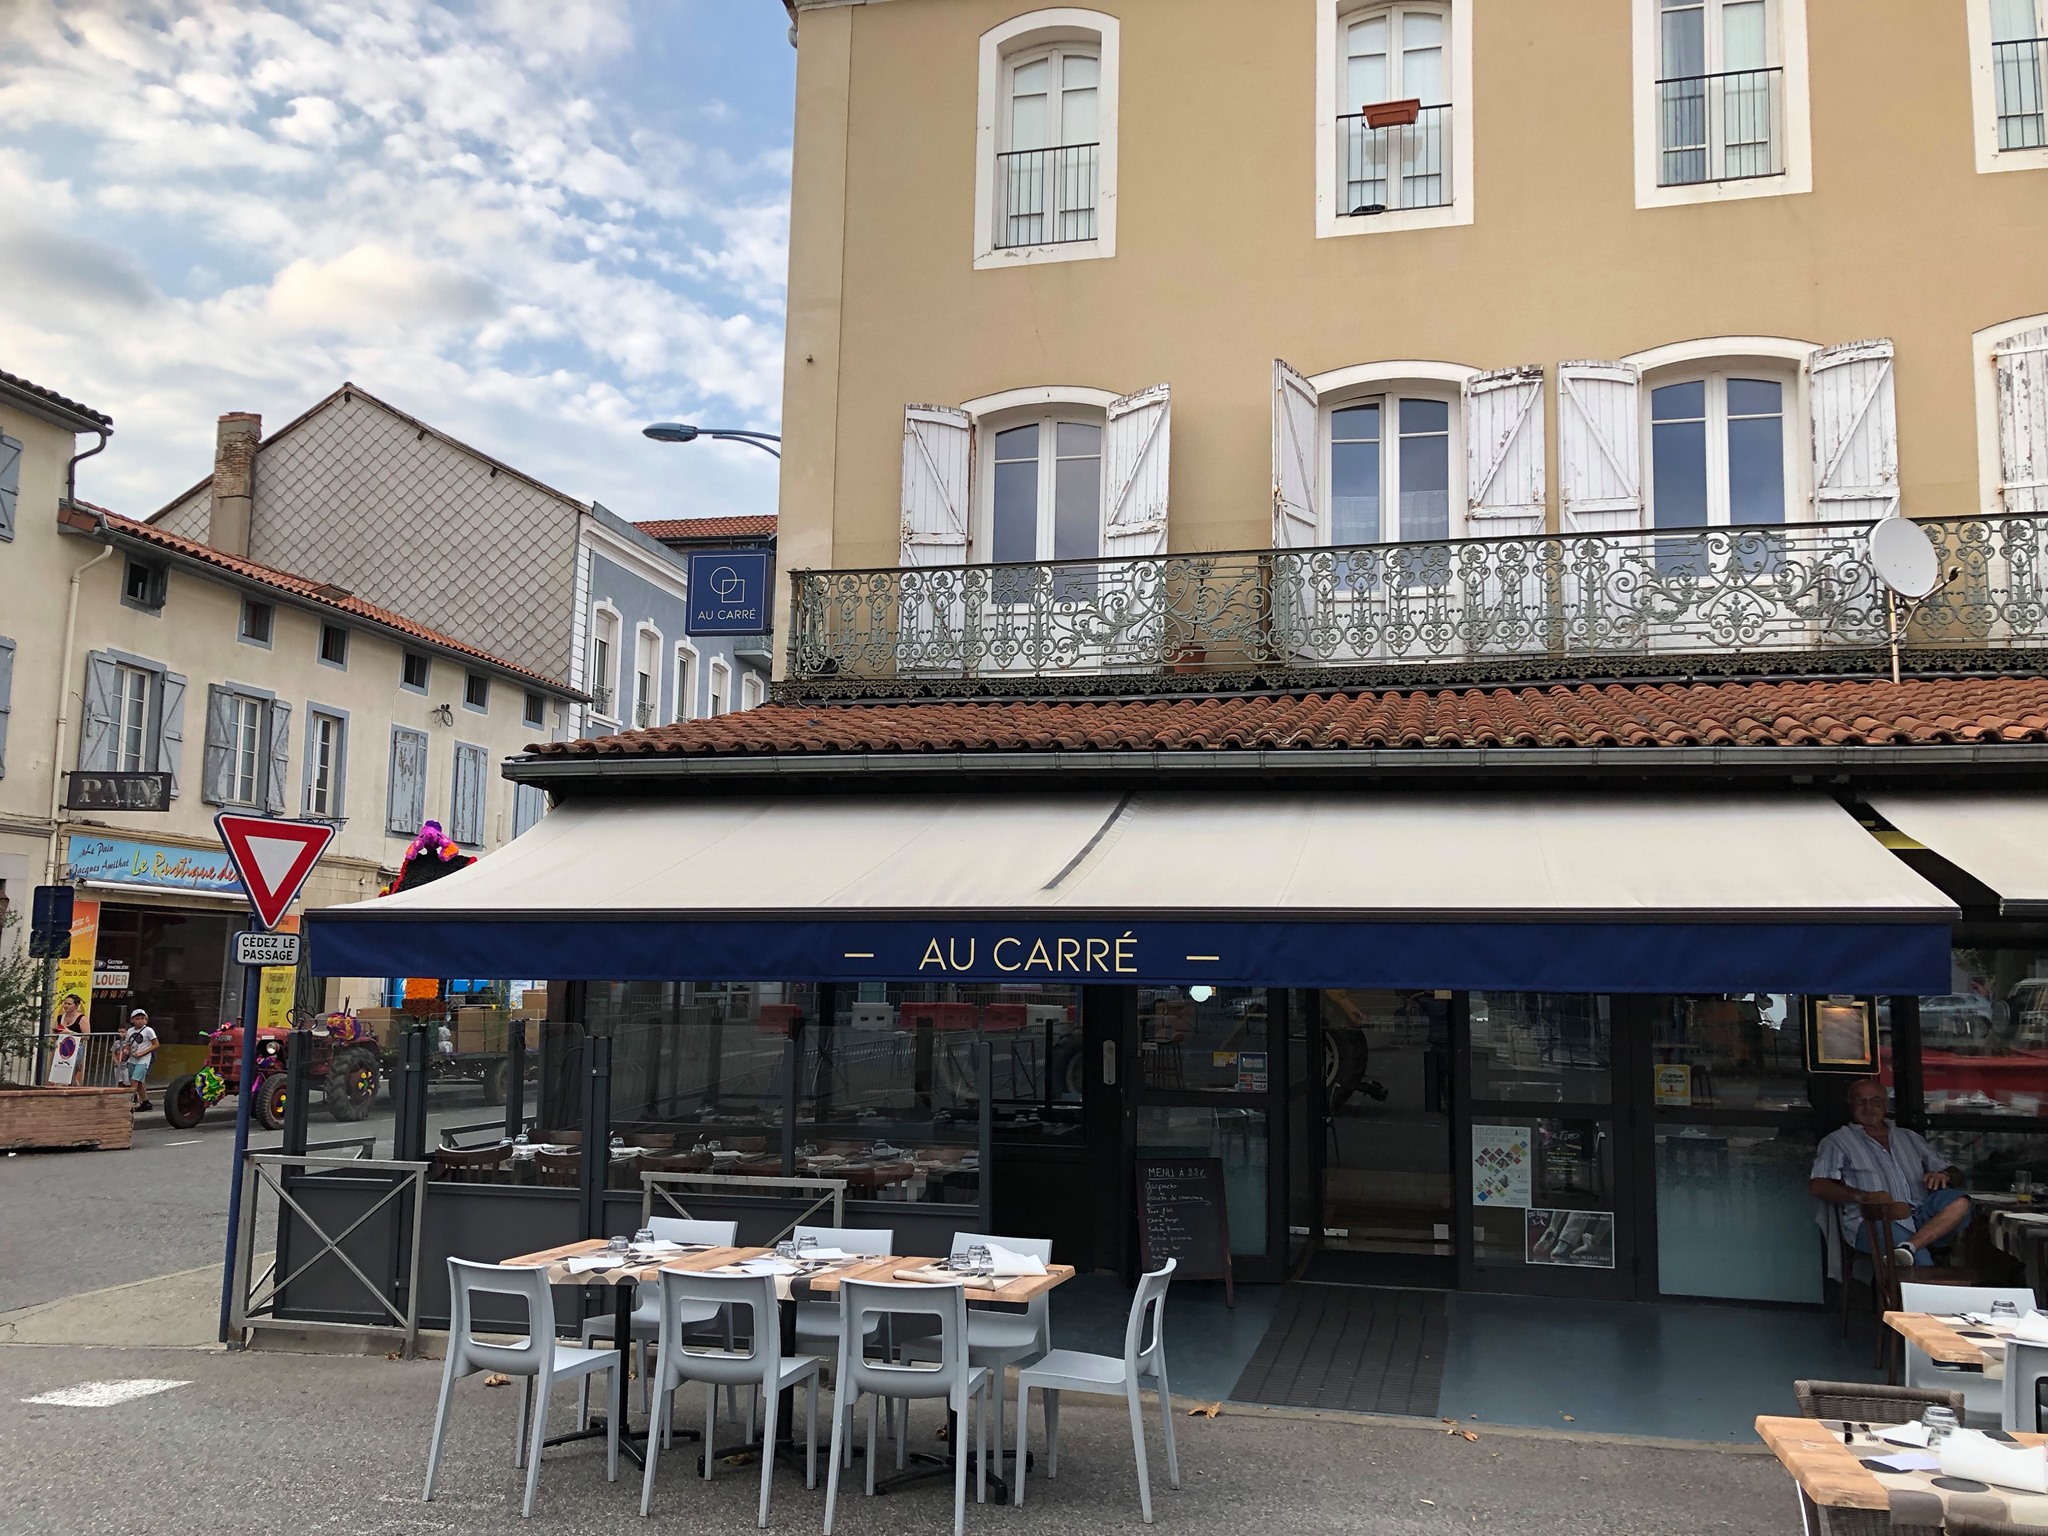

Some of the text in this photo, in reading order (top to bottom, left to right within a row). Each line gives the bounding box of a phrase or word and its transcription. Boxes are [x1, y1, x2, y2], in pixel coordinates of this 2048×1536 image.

[697, 607, 756, 620] AU CARRÉ
[80, 775, 163, 807] PAIN
[96, 842, 114, 856] Pain
[132, 849, 149, 876] Le
[152, 851, 216, 887] Rustique
[242, 934, 296, 948] CÉDEZ LE
[243, 949, 293, 961] PASSAGE
[918, 930, 1138, 973] AU CARRÉ
[95, 974, 127, 986] LOUER
[1148, 1167, 1175, 1178] MENU
